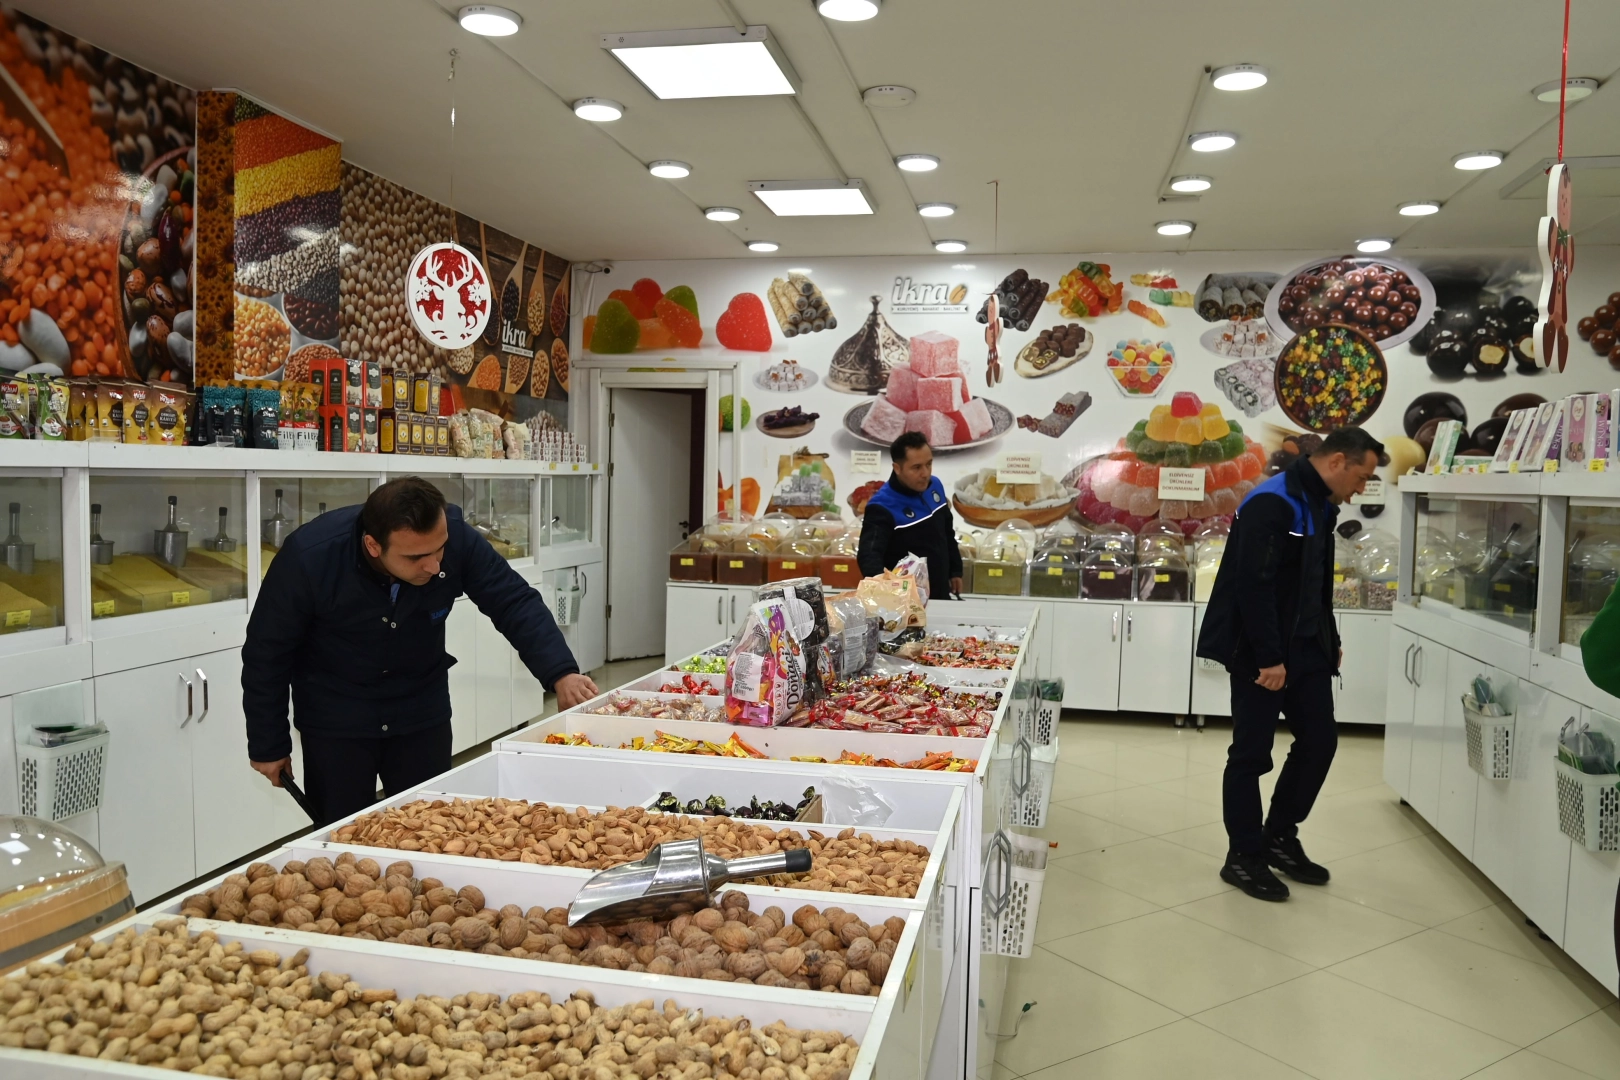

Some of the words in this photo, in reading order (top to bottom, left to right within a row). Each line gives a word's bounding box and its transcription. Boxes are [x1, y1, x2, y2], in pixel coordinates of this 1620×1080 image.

[893, 277, 948, 305] ikra
[502, 318, 527, 348] ikra
[782, 651, 800, 710] Donaci
